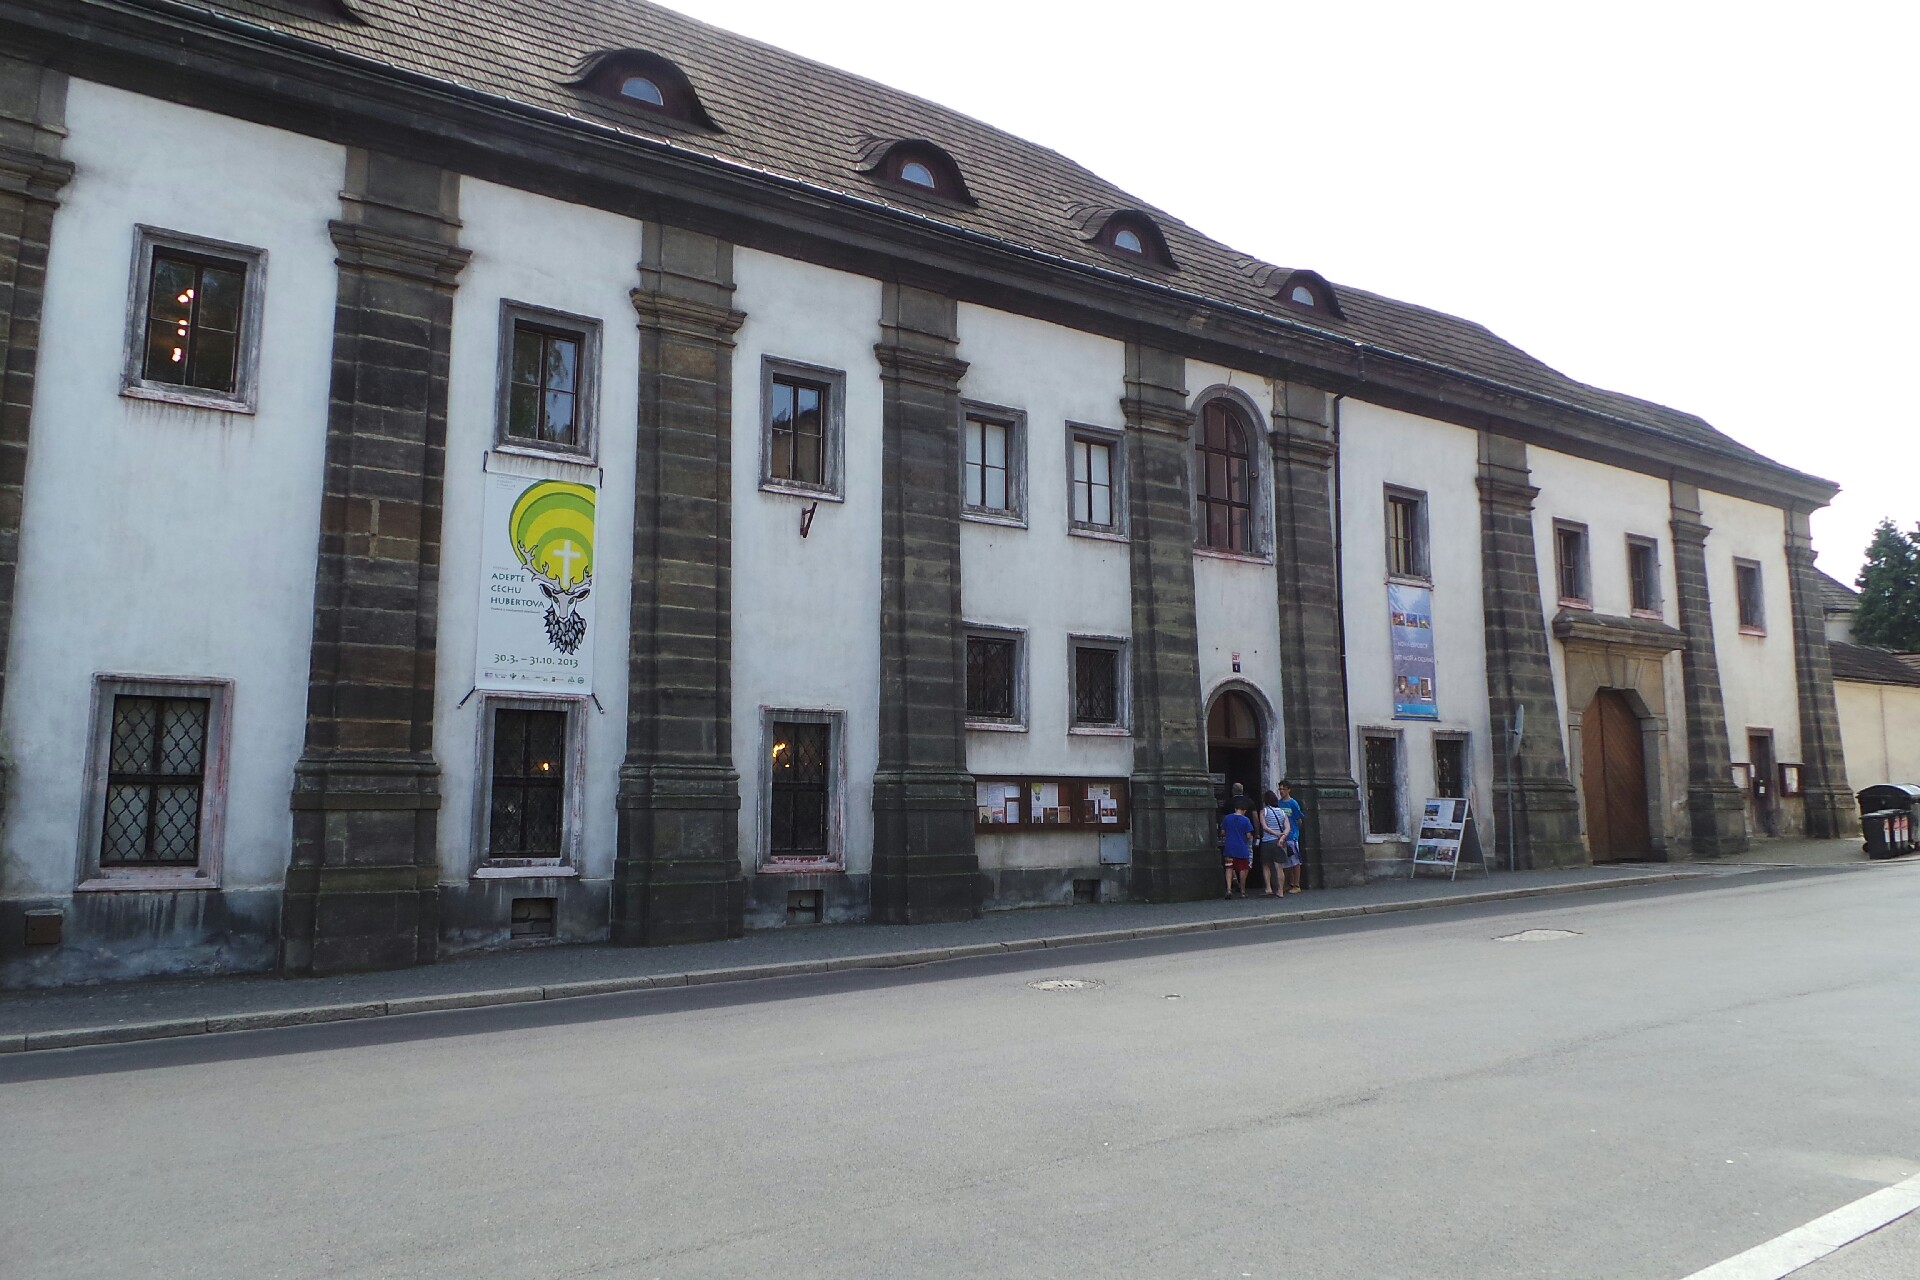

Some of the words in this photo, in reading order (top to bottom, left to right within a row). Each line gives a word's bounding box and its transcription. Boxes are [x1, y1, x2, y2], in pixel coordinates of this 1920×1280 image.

[492, 573, 525, 583] ADEPTE
[491, 585, 522, 594] CECHU
[490, 596, 545, 608] HUBERTOVA
[493, 654, 518, 664] 30.3.
[529, 656, 555, 666] 31.10.
[557, 658, 579, 669] 2013
